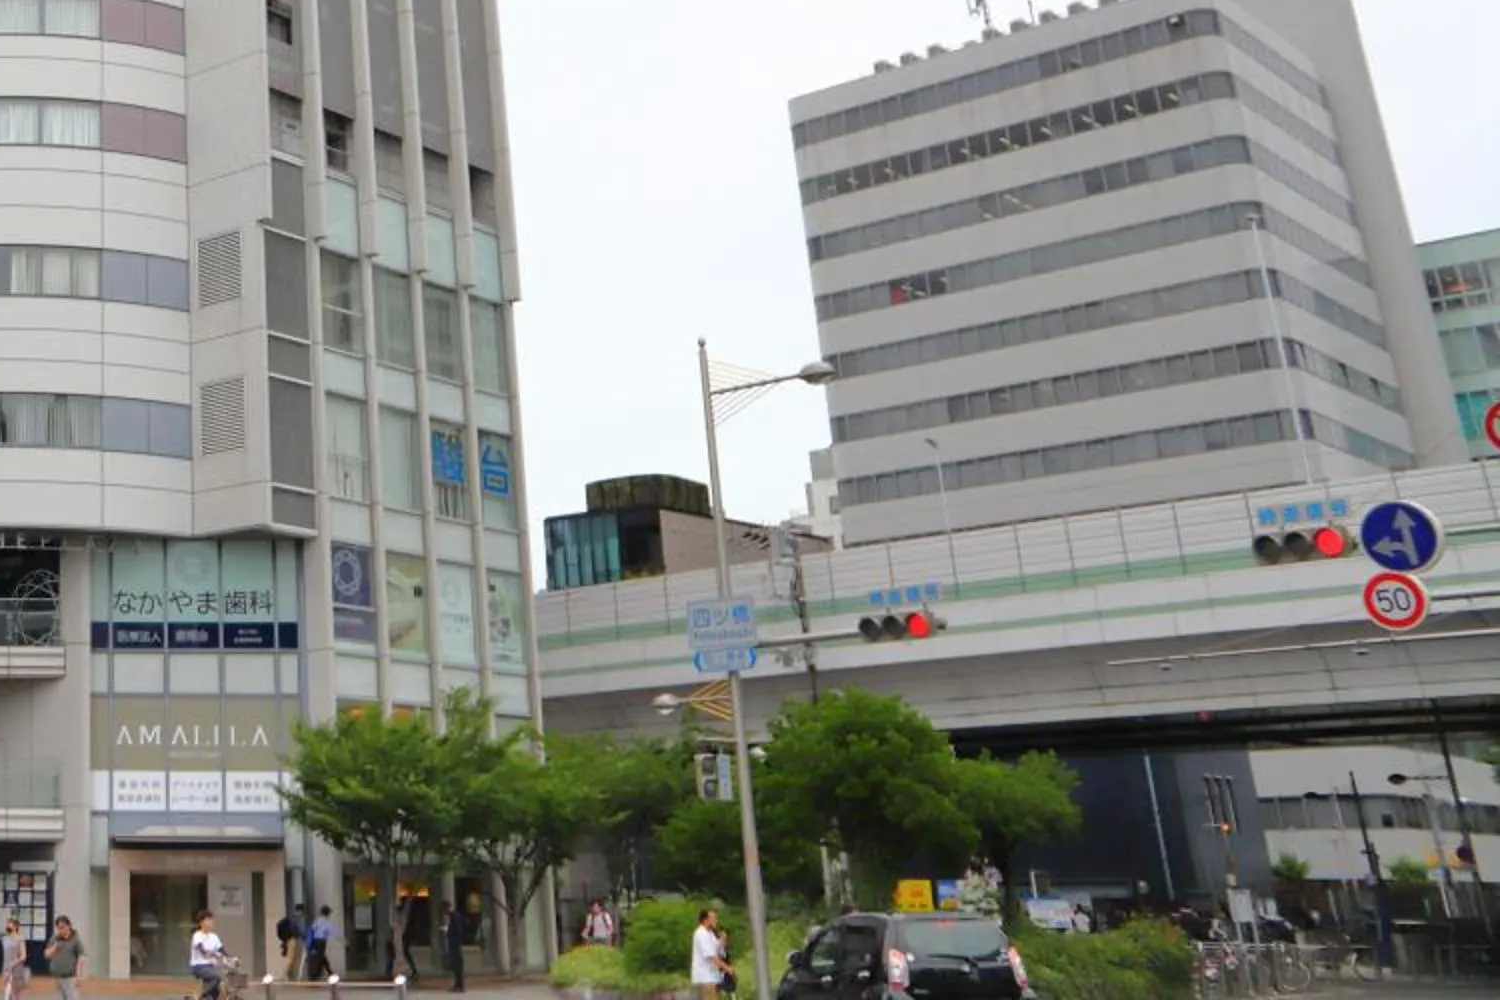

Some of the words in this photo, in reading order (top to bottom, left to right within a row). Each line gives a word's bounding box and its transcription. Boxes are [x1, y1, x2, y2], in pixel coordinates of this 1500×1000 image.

[113, 590, 275, 615] なかやま歯科
[1376, 588, 1412, 613] 50
